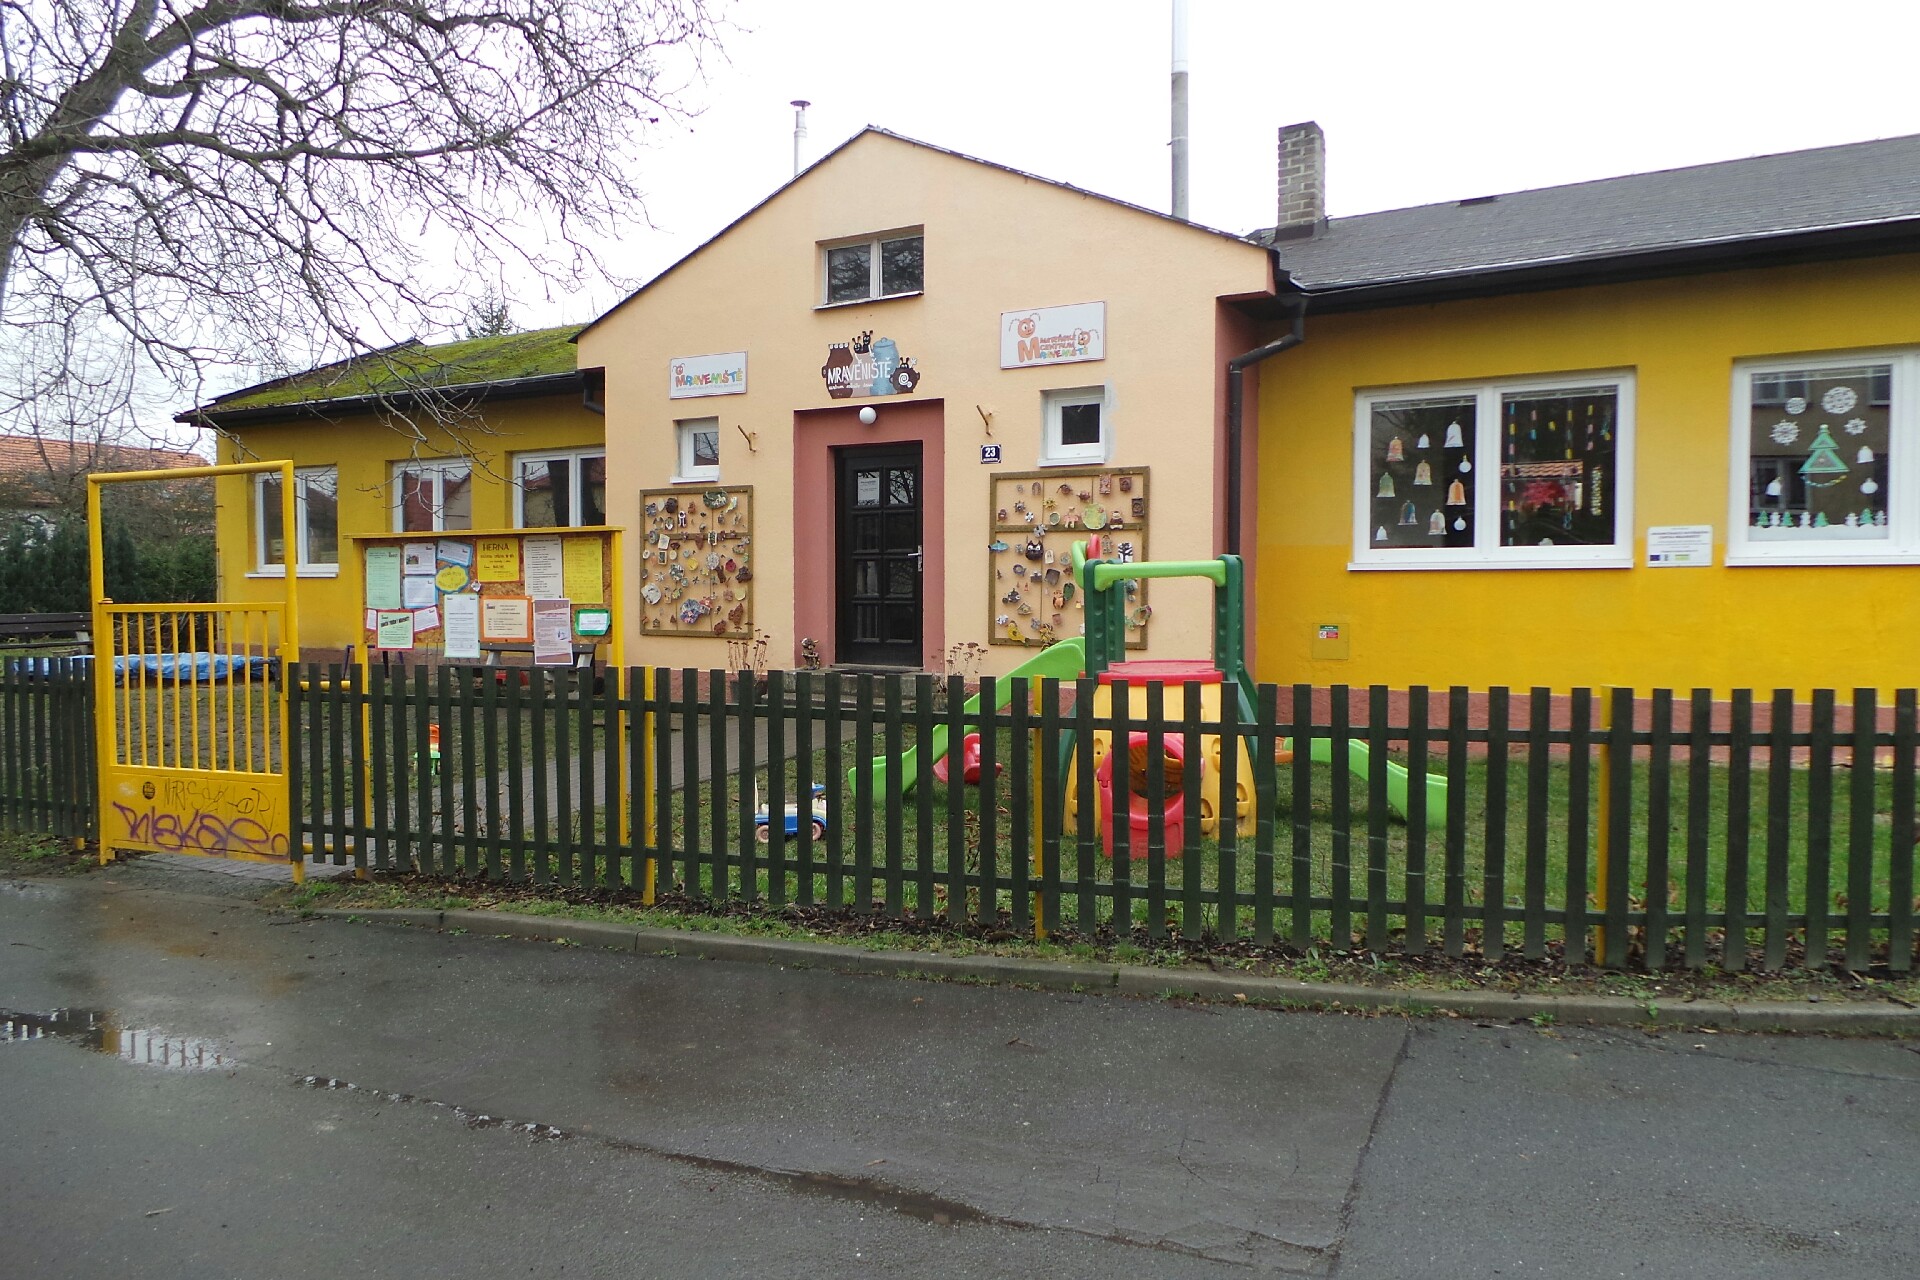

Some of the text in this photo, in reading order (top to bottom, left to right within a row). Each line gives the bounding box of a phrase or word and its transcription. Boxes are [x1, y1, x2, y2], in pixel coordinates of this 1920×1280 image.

[1040, 342, 1076, 351] CENTRUM
[985, 447, 996, 457] 23
[482, 543, 510, 551] HERNA
